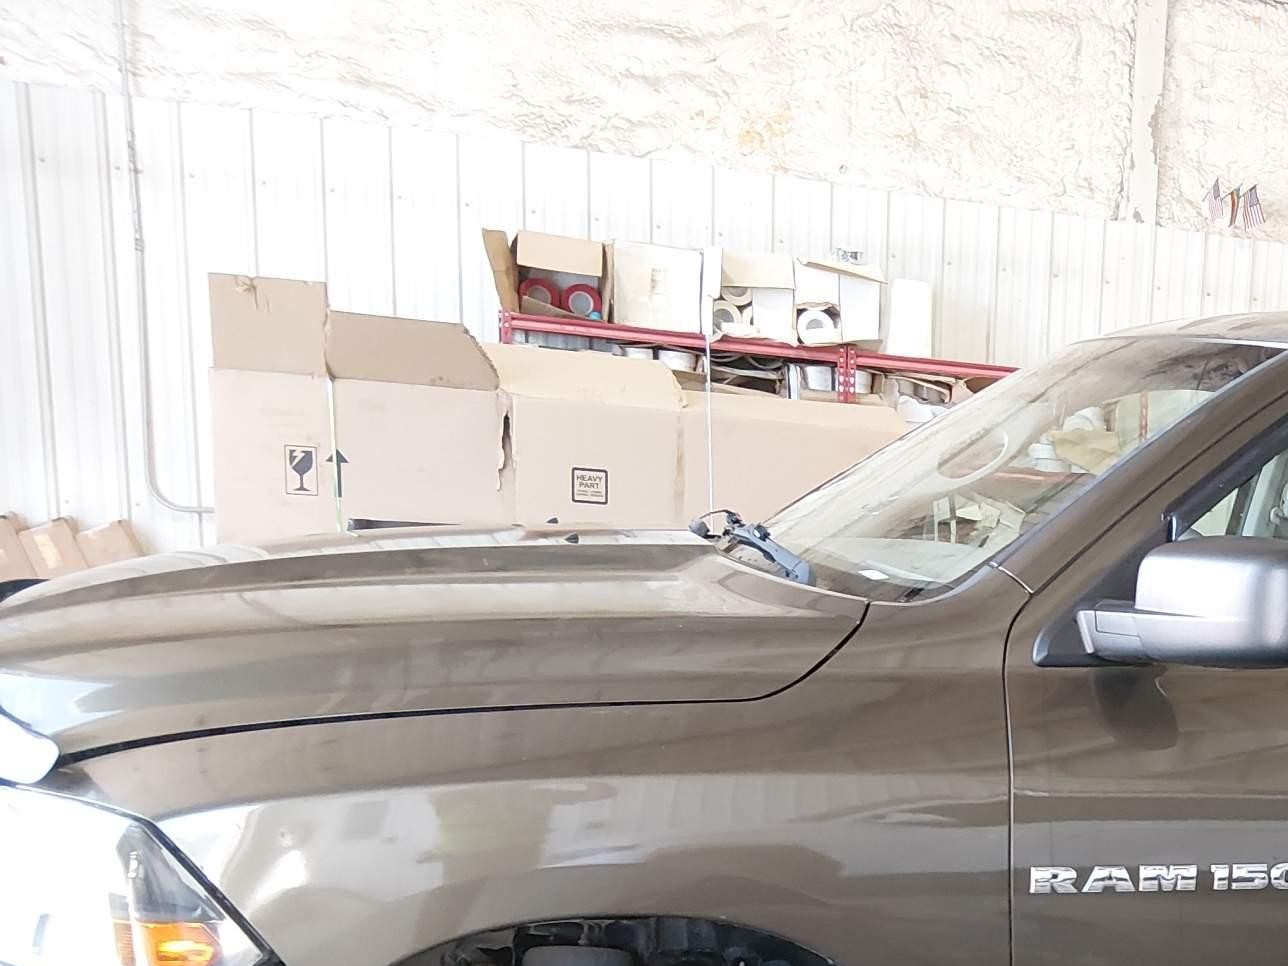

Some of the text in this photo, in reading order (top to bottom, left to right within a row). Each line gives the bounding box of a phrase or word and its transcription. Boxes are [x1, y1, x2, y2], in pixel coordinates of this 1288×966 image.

[576, 474, 603, 483] HEAVY
[579, 481, 599, 489] PART
[1029, 864, 1198, 894] RAM
